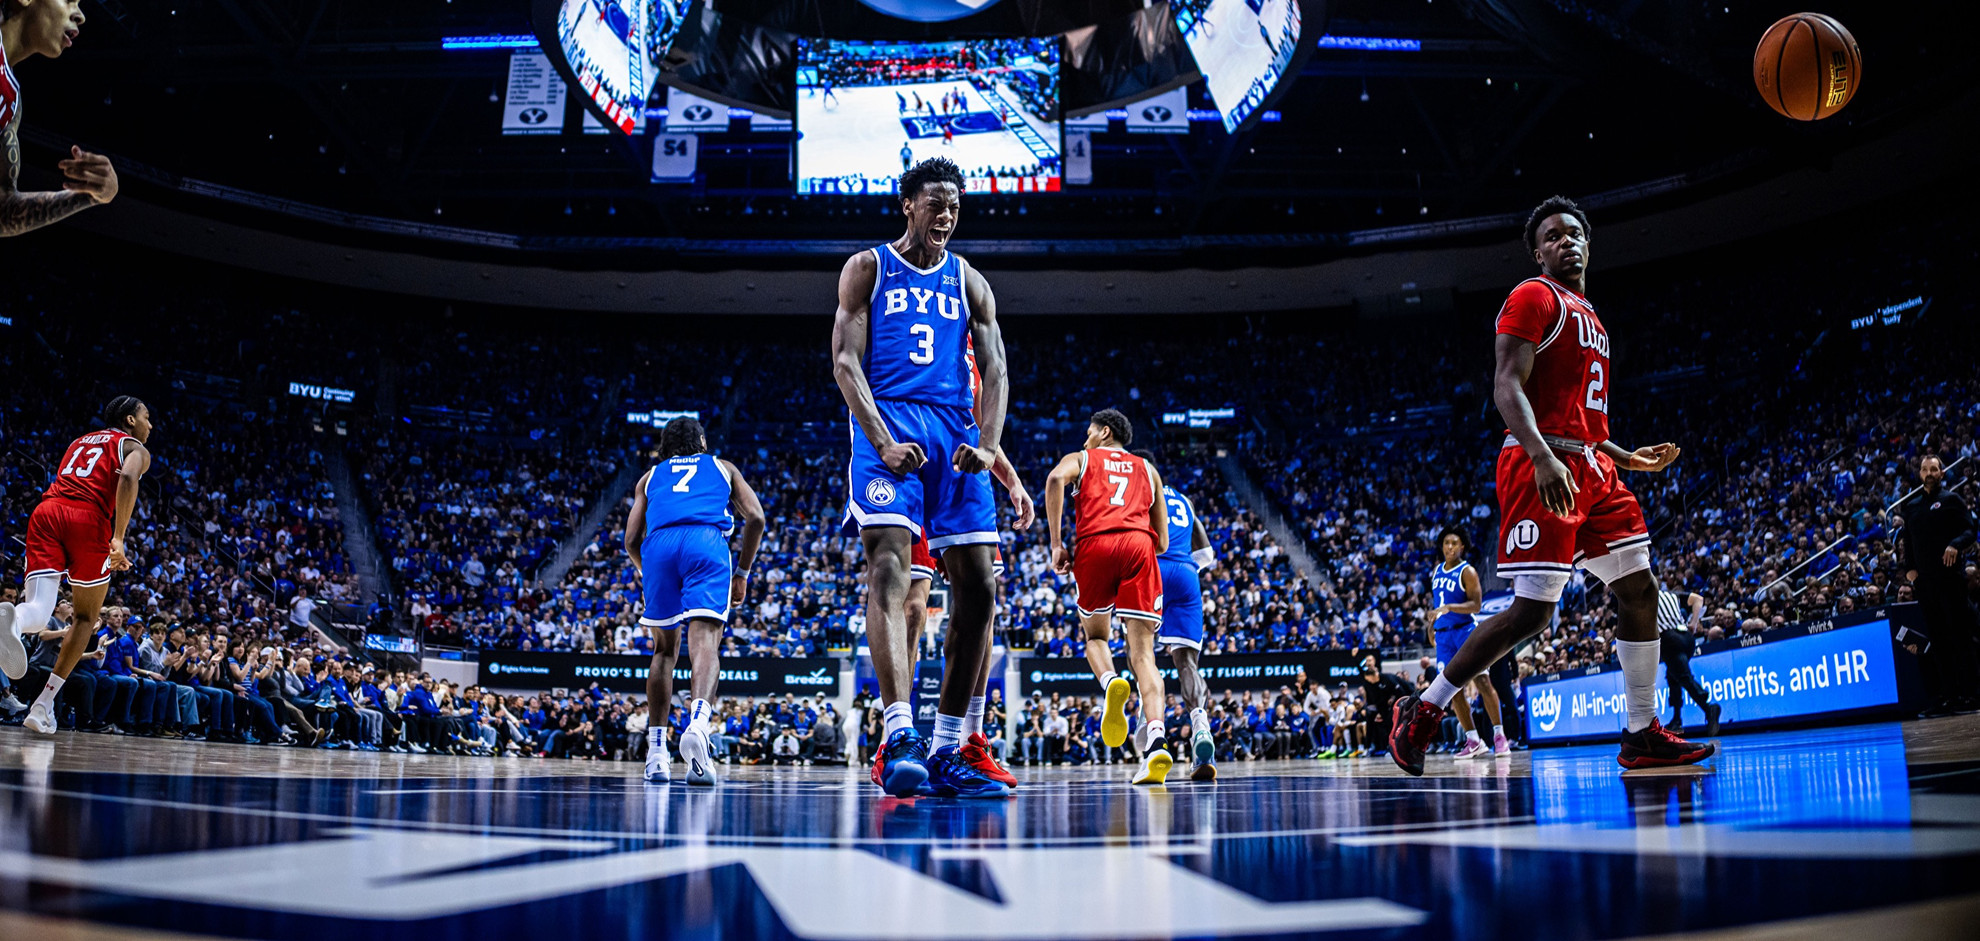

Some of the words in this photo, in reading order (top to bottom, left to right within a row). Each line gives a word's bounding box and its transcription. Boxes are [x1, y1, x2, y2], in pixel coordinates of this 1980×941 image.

[664, 139, 688, 156] 54
[1066, 140, 1086, 157] 4
[885, 287, 960, 320] BYU
[1851, 315, 1874, 330] BYU
[909, 323, 935, 365] 3
[289, 382, 322, 398] BYU
[1163, 413, 1185, 424] BYU
[1189, 408, 1234, 418] Independent
[61, 446, 103, 478] 13
[1103, 458, 1133, 473] HAYES
[671, 464, 698, 493] 7
[1108, 474, 1129, 506] 7
[1166, 498, 1190, 528] 3
[1517, 524, 1535, 545] U
[1432, 577, 1457, 592] BYU
[575, 666, 632, 678] PROVO'S
[635, 668, 649, 679] BE
[672, 669, 692, 680] FLI
[719, 670, 759, 681] DEALS
[784, 674, 834, 685] Breeze
[1198, 667, 1214, 679] ST
[1217, 666, 1261, 678] FLIGHT
[1265, 664, 1304, 677] DEALS
[1571, 690, 1628, 719] All-in-on
[1701, 665, 1785, 703] benefits,
[1789, 655, 1830, 692] and
[1833, 649, 1870, 685] HR
[1532, 688, 1562, 721] eddy
